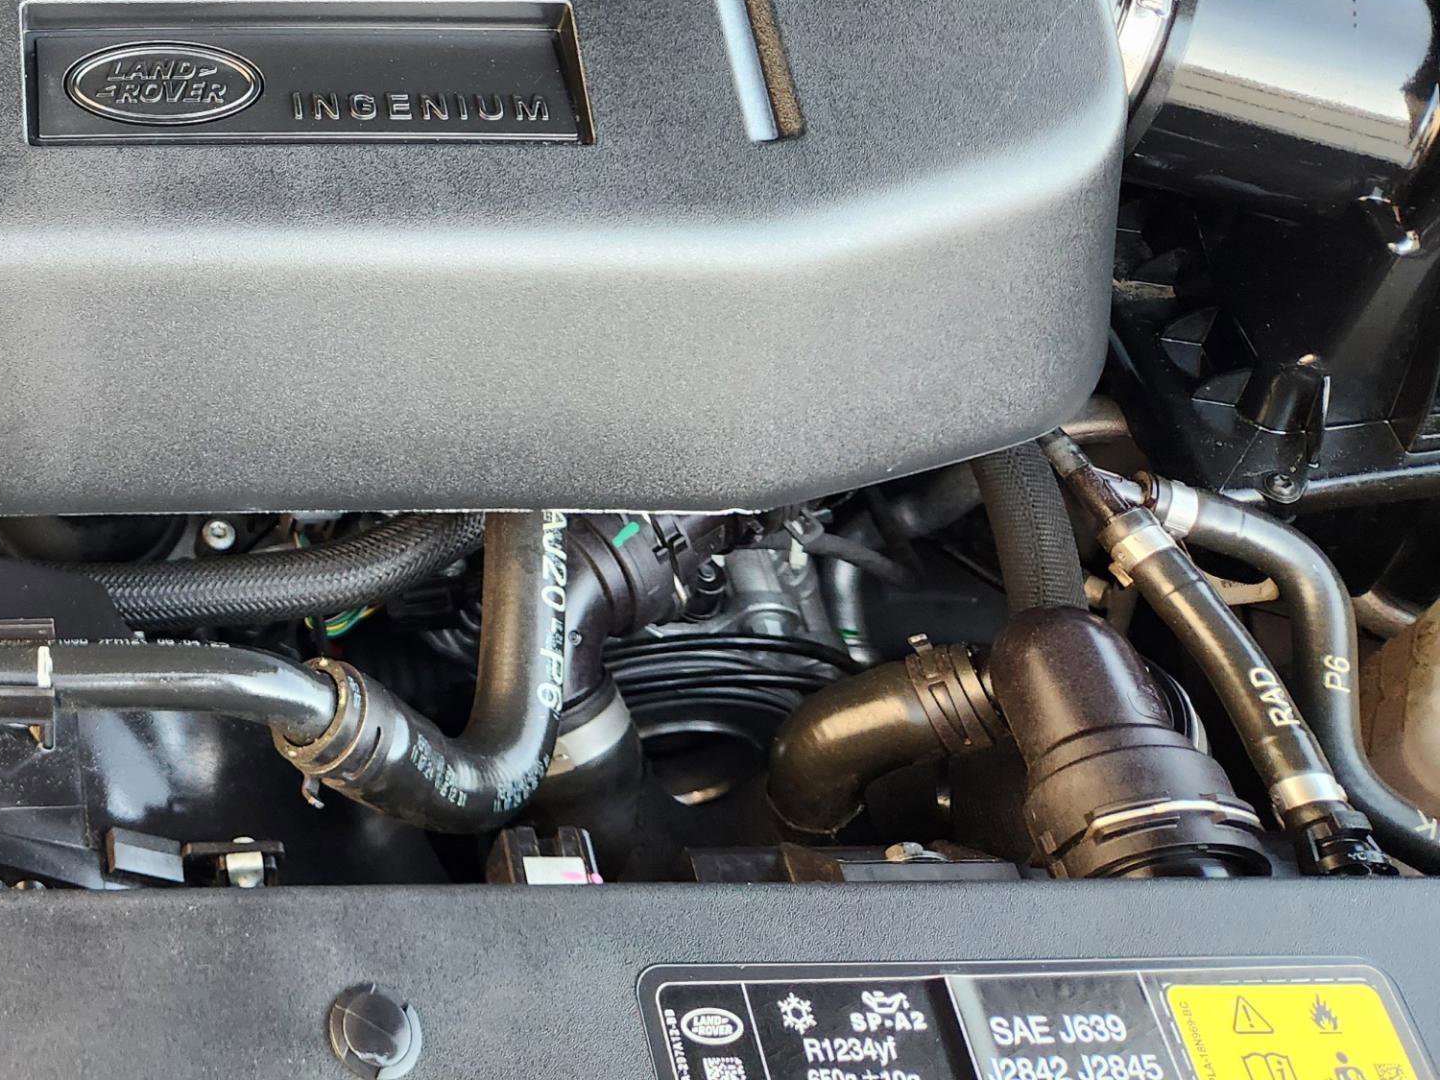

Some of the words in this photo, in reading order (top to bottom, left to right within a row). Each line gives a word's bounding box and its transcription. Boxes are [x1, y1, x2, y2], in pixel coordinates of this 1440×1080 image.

[107, 60, 205, 81] LAND
[114, 80, 227, 105] ROVER
[292, 92, 550, 122] INGENIUM
[1323, 654, 1352, 694] P6
[1248, 666, 1301, 727] RAD
[692, 1014, 722, 1026] LAND
[697, 1024, 734, 1036] ROVER
[849, 1011, 928, 1032] SP-A2
[990, 1015, 1055, 1046] SAE
[1059, 1014, 1128, 1044] J639
[803, 1035, 898, 1067] R1234yf
[986, 1055, 1073, 1080] J2842
[1077, 1054, 1164, 1080] J2845
